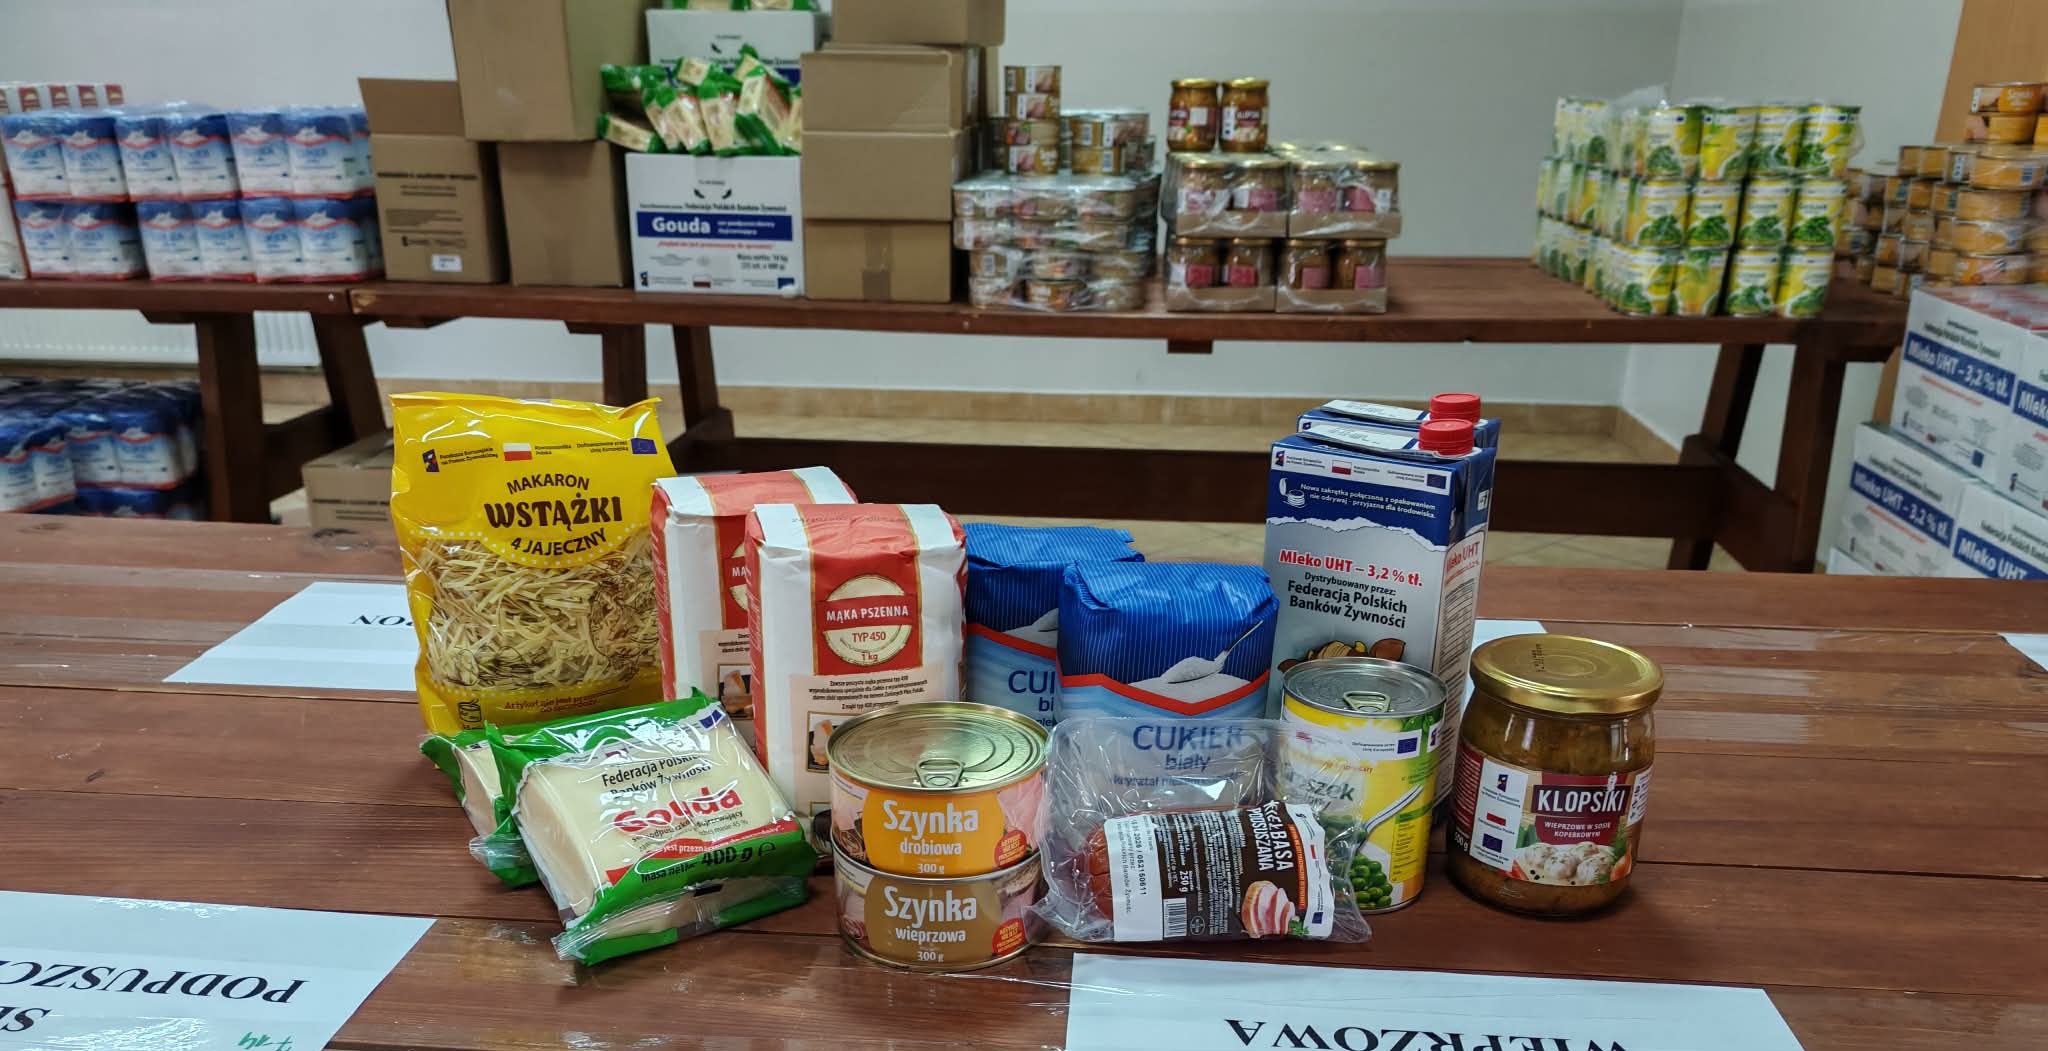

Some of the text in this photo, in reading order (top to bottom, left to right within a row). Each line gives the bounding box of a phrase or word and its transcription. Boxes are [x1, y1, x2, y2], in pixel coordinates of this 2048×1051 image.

[652, 217, 711, 234] Gouda
[506, 473, 590, 494] MAKARON
[1301, 484, 1319, 492] Nowa
[483, 492, 623, 531] WSTĄŻKI
[510, 528, 607, 556] 4 JAJECZNY
[1959, 538, 1997, 572] Mleko
[1279, 550, 1322, 568] Mleko
[1324, 556, 1353, 573] UHT
[1367, 564, 1389, 580] 3,2
[1392, 569, 1405, 582] %
[1407, 573, 1423, 586] tł.
[1304, 572, 1396, 597] Dystrybuowany przez:
[1288, 580, 1407, 614] Federacja Polskich
[826, 604, 909, 624] MĄKA PSZENNA
[1289, 596, 1406, 628] Banków Żywności
[852, 630, 887, 643] TYP 450
[861, 651, 879, 663] 1 kg
[1132, 724, 1243, 751] CUKIER
[602, 762, 658, 786] Federacja
[1164, 753, 1212, 771] biały
[614, 787, 743, 833] Gouda
[1537, 789, 1626, 813] KLOPSIKI
[882, 799, 979, 841] Szynka
[1544, 821, 1611, 831] WIEPRZOWE W SOSIE
[1247, 807, 1274, 871] PODSUSZANA
[1263, 800, 1295, 871] KIEŁBASA
[1554, 830, 1601, 839] KOPERKOWYM
[702, 847, 737, 867] 400
[900, 839, 962, 856] drobiowa
[918, 863, 937, 873] 300
[1180, 871, 1189, 885] 250
[883, 886, 977, 929] Szynka
[895, 927, 966, 945] wieprzowa
[917, 951, 936, 961] 300
[0, 960, 309, 1003] PODPUSZC
